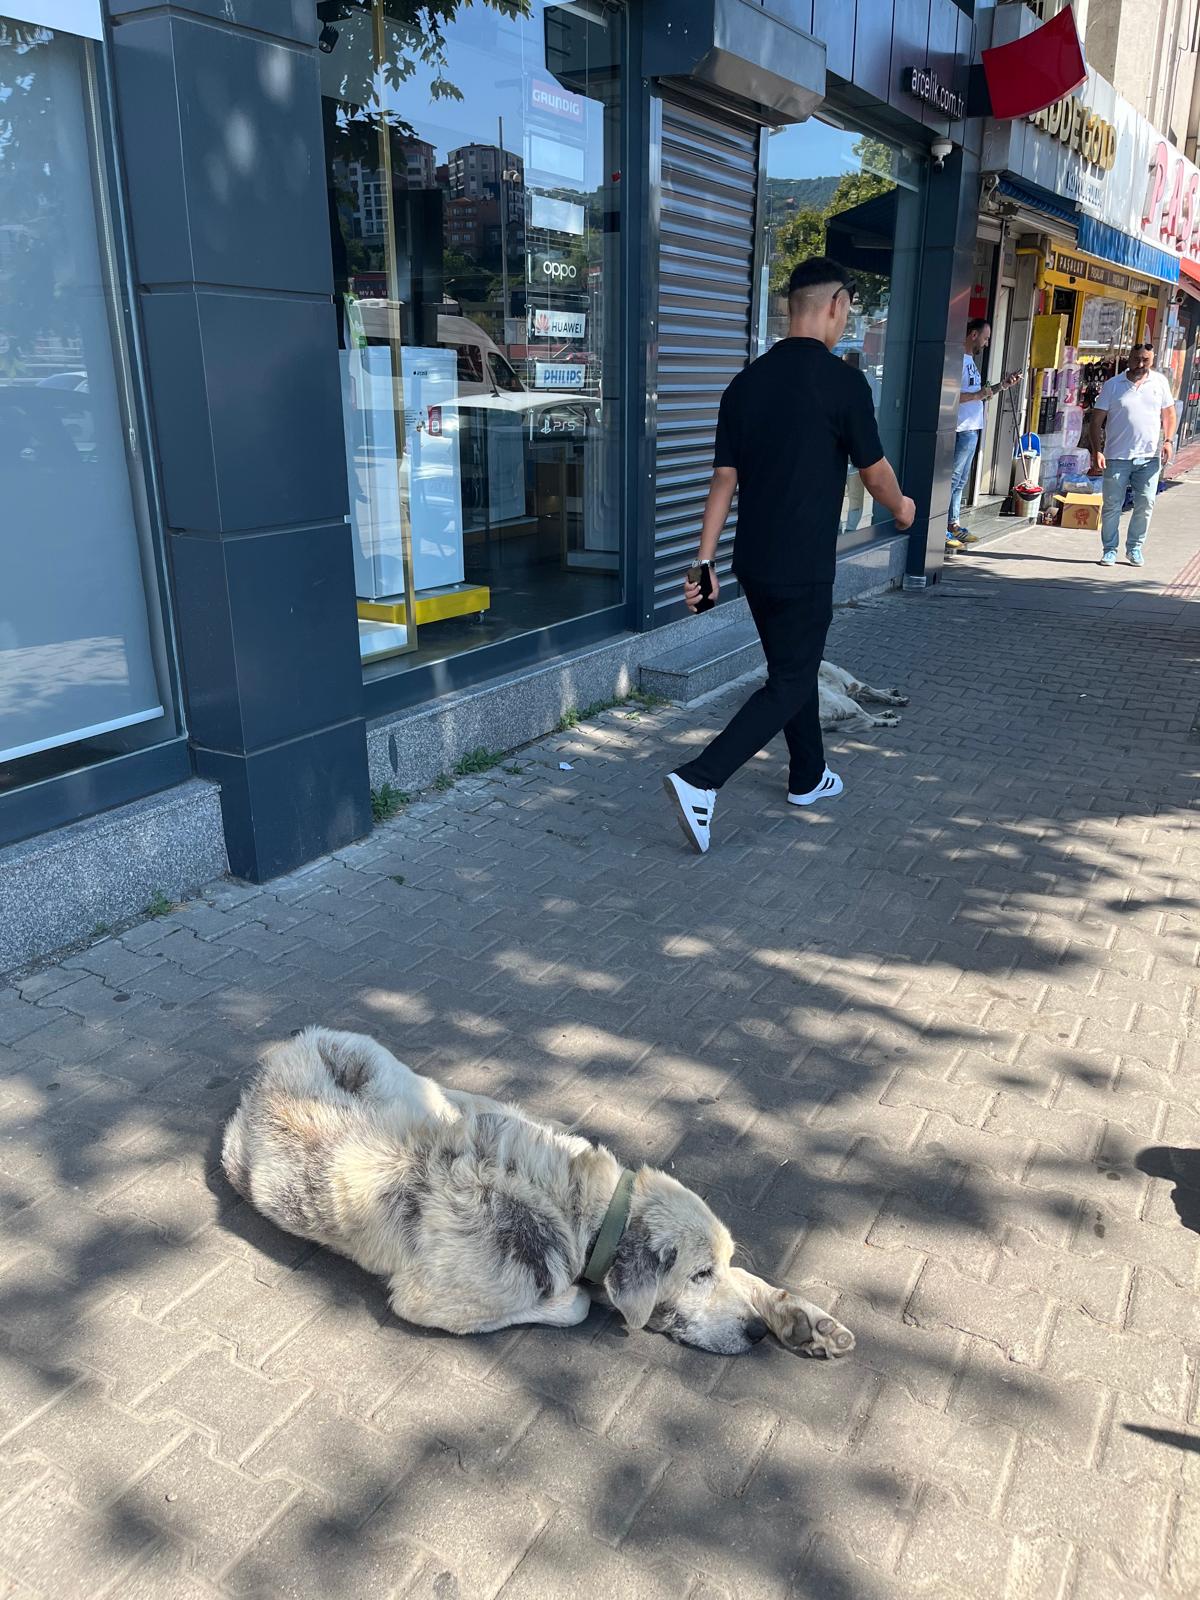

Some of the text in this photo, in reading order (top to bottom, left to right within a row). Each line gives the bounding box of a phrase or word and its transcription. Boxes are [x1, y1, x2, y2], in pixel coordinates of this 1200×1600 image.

[911, 67, 965, 119] arcelik.com.tr
[532, 89, 580, 116] GRUNDIG
[543, 260, 577, 280] oppo
[551, 320, 582, 334] HUAWEI
[543, 369, 582, 384] PHILIPS
[552, 420, 576, 432] PS5
